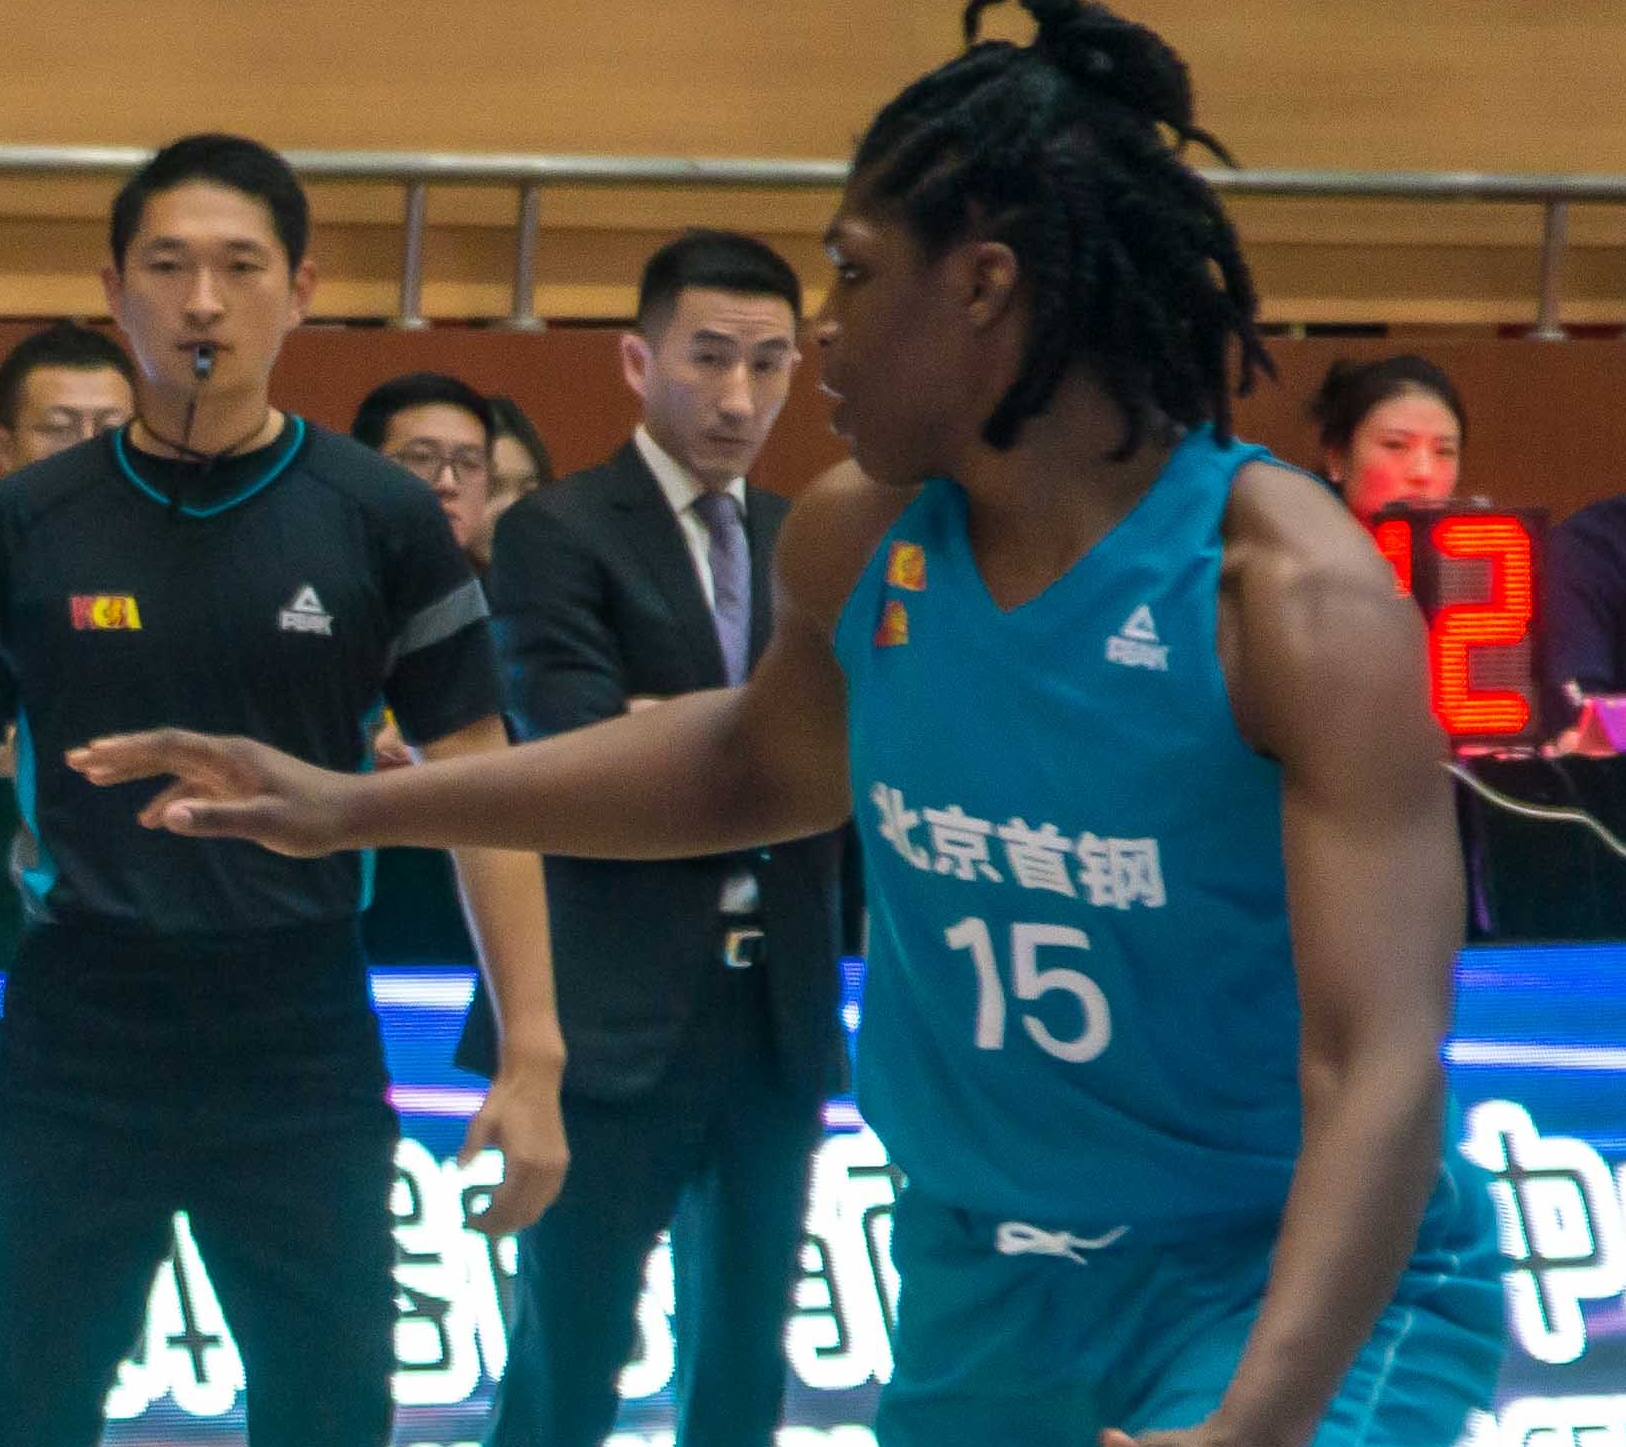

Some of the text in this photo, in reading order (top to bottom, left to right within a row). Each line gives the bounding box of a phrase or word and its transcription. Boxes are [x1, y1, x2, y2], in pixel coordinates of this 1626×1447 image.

[871, 783, 1166, 910] 北京首钢
[944, 917, 1112, 1063] 15
